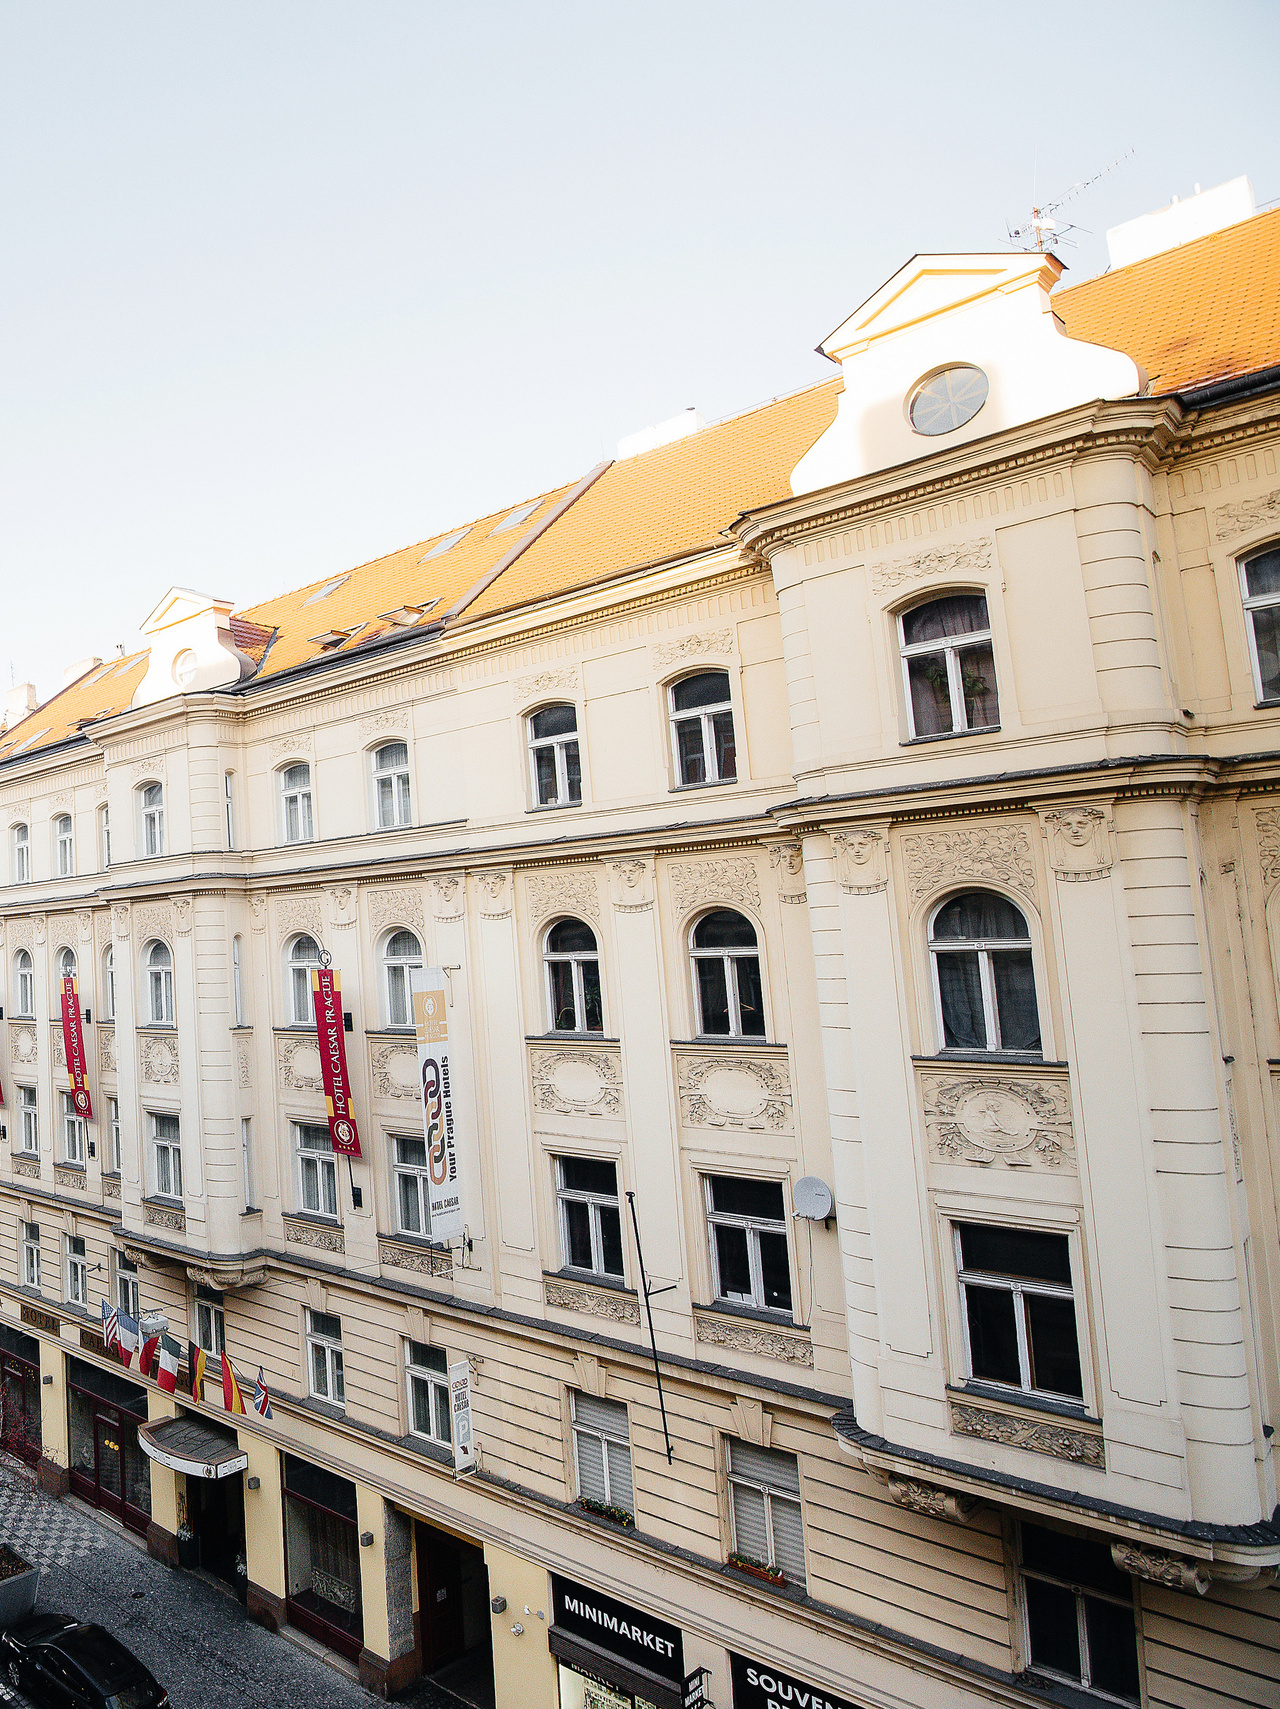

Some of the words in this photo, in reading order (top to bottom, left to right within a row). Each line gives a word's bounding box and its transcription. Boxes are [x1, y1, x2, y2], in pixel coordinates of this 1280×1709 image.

[65, 982, 75, 1018] PRAGUE
[321, 975, 336, 1023] PRAGUE
[69, 1021, 79, 1056] CAESAR
[327, 1026, 341, 1074] CAESAR
[74, 1057, 84, 1087] HOTEL
[441, 1056, 451, 1099] Hotels
[333, 1075, 346, 1115] HOTEL
[445, 1101, 455, 1149] Prague
[448, 1152, 457, 1182] Your
[443, 1196, 459, 1208] CAESAR
[22, 1303, 59, 1333] HOTEL
[564, 1594, 674, 1658] MINIMARKET
[688, 1675, 700, 1692] MINI
